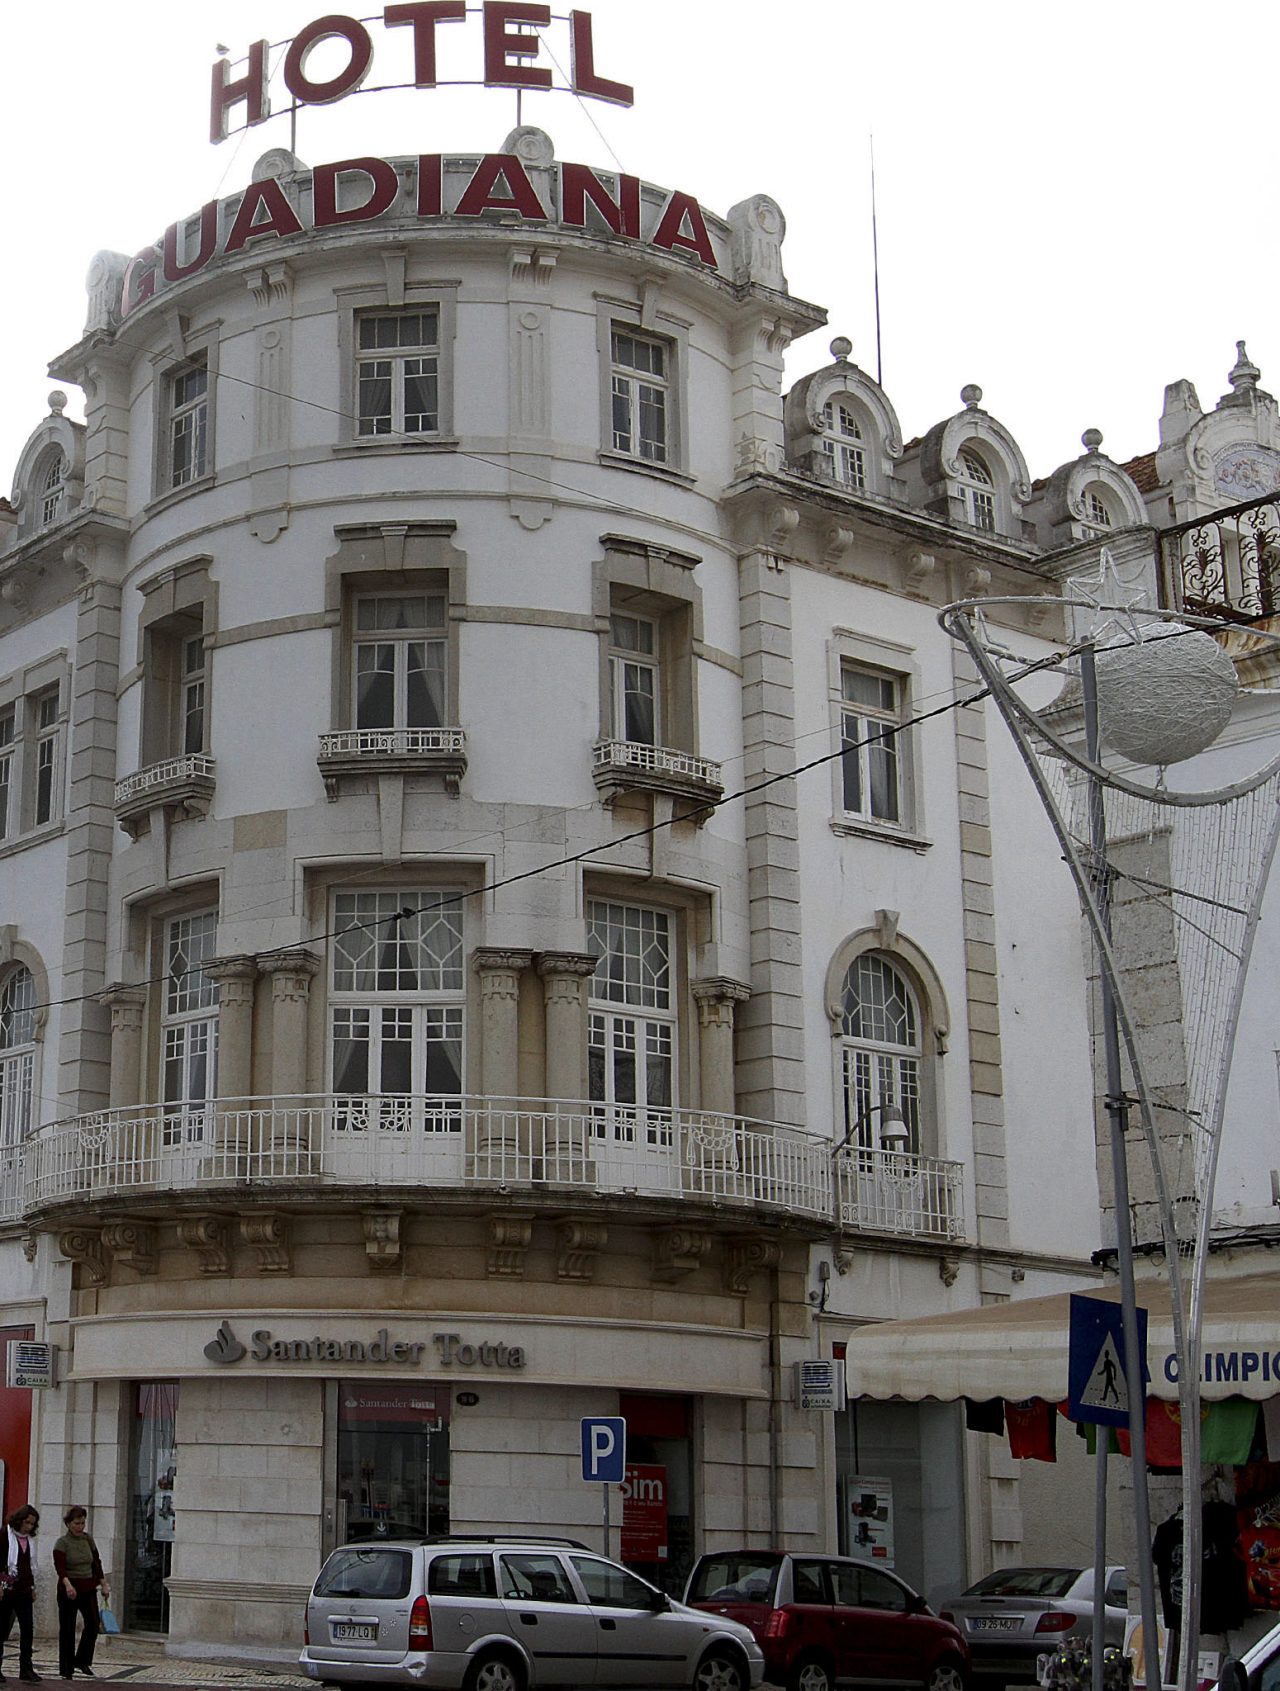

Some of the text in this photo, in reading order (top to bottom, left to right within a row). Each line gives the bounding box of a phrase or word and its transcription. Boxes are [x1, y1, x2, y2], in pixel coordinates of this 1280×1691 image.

[210, 0, 634, 145] HOTEL
[121, 153, 719, 315] GUADIANA
[251, 1328, 526, 1368] Santander Totta
[1164, 1352, 1280, 1382] OIMPI
[359, 1398, 407, 1408] Santander
[591, 1425, 615, 1475] P
